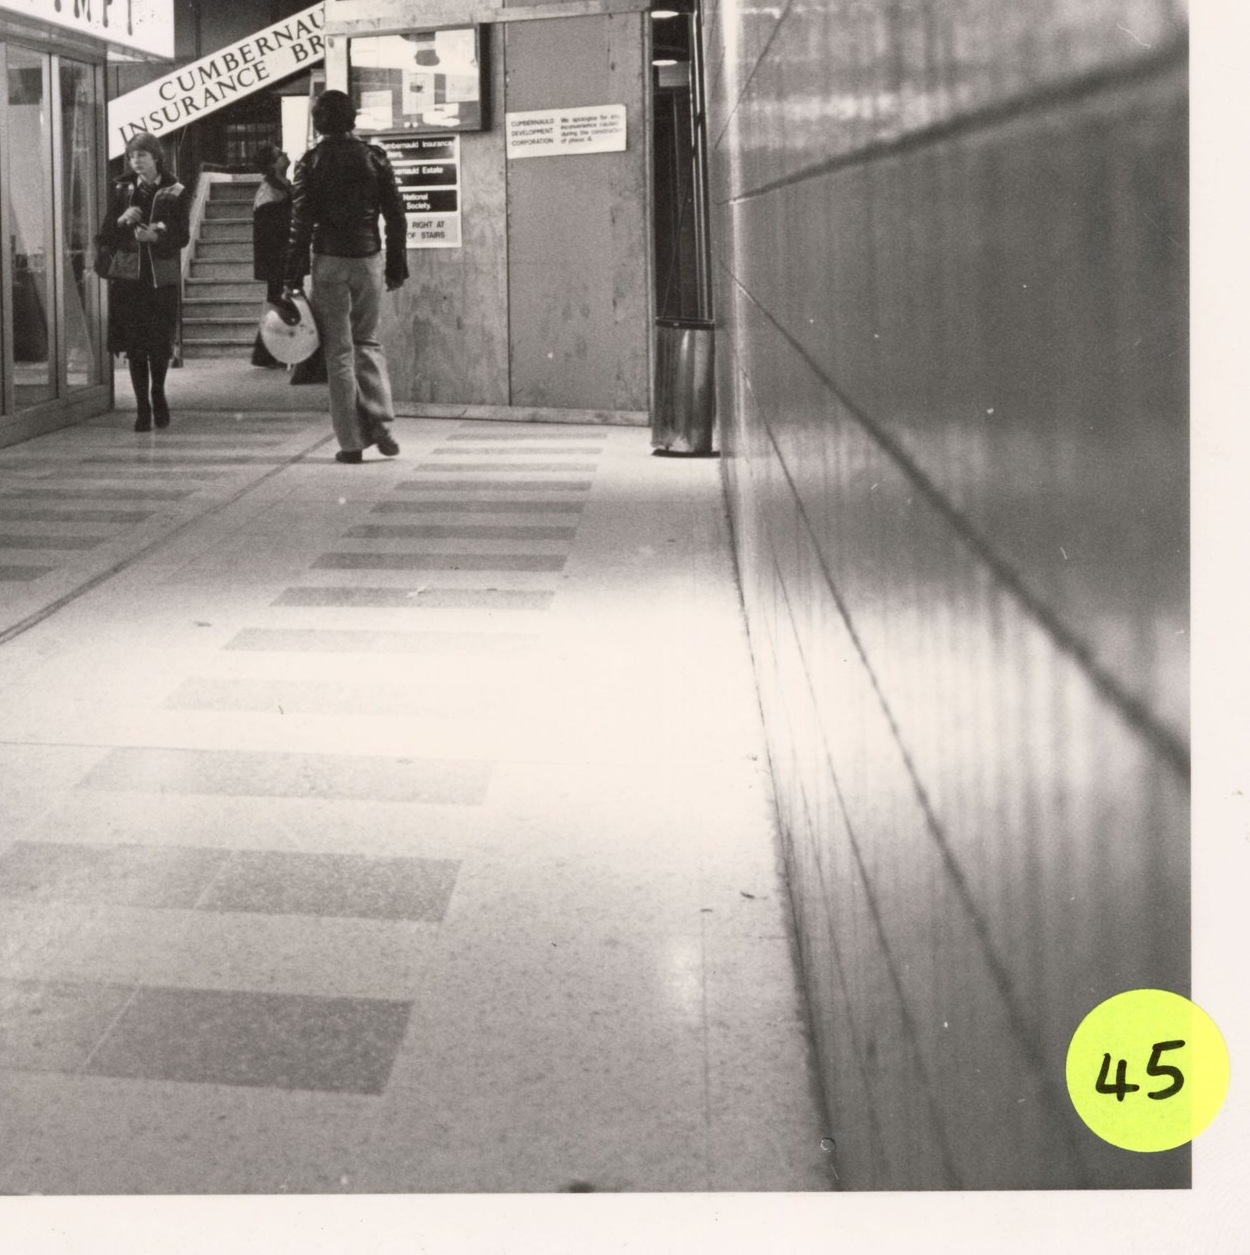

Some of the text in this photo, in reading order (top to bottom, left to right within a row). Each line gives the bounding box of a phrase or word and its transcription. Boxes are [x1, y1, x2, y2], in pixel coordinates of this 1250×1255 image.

[158, 7, 326, 102] CUMBERNAU
[118, 33, 326, 144] INSURANCE BR
[510, 118, 555, 127] CUMBERNAULD
[511, 128, 554, 137] DEVELOPMENT
[422, 140, 453, 148] Insurance
[511, 138, 554, 146] CORPORATION
[422, 166, 444, 174] Estate
[403, 193, 429, 201] National
[412, 220, 445, 229] RIGHT AT
[421, 231, 446, 239] STAIRS
[1095, 1039, 1186, 1102] 45
